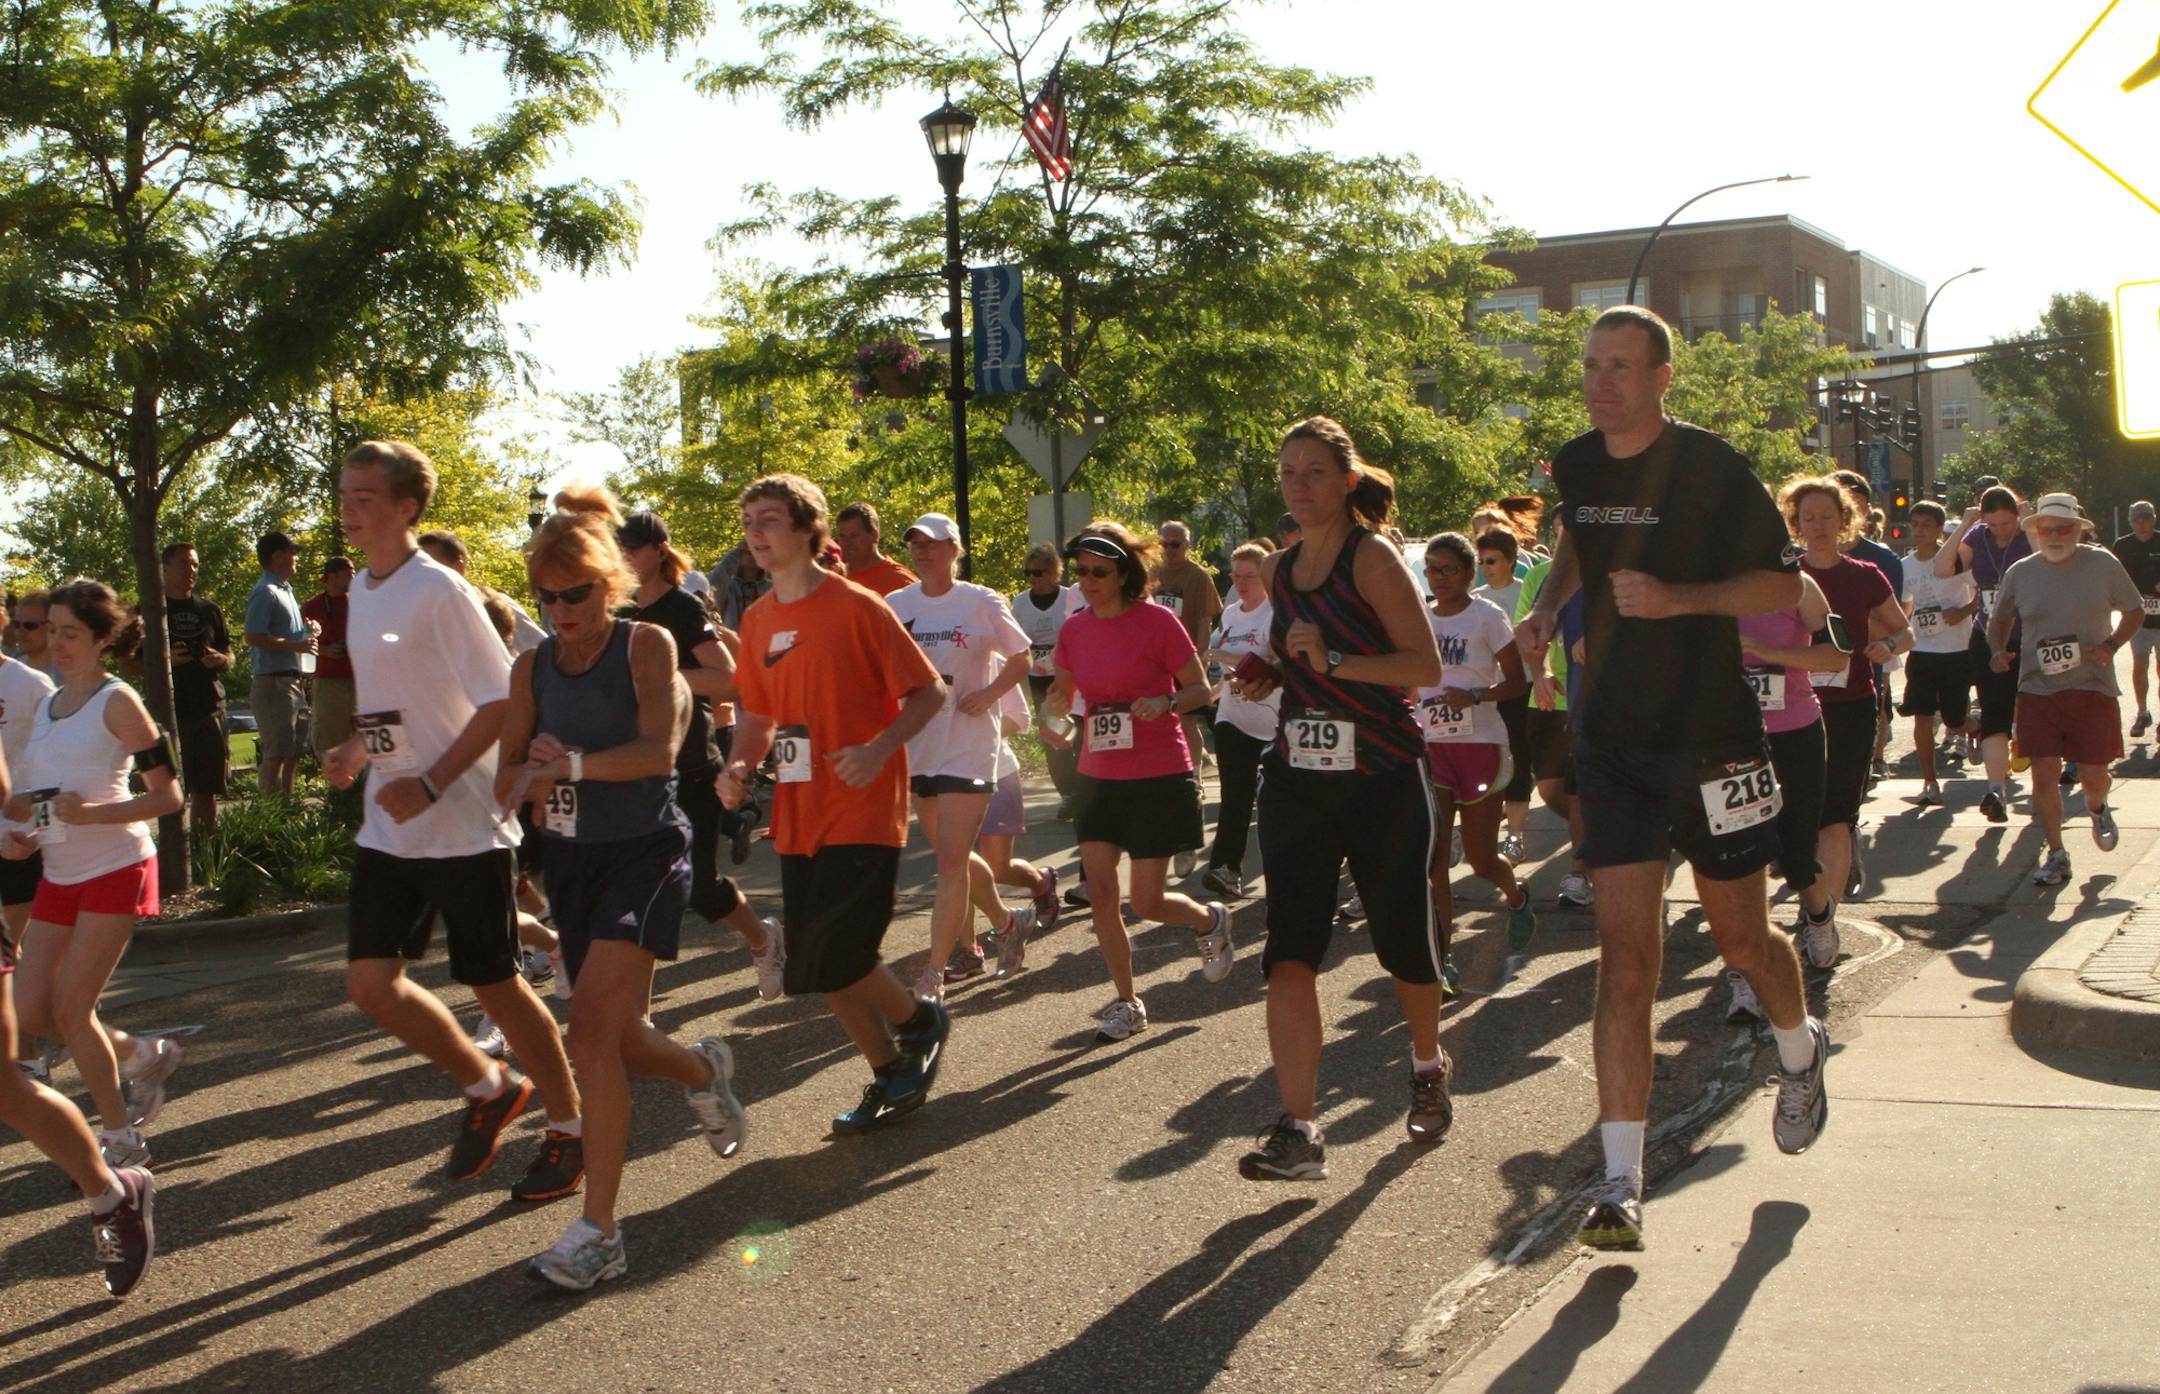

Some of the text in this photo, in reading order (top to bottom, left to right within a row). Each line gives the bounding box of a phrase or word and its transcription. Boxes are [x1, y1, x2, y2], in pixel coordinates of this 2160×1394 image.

[980, 278, 1002, 370] Burnsville
[1917, 613, 1937, 627] 132
[2041, 644, 2073, 664] 206
[1093, 714, 1122, 737] 199
[1297, 721, 1340, 750] 219
[365, 727, 396, 754] 78
[1721, 768, 1774, 811] 218
